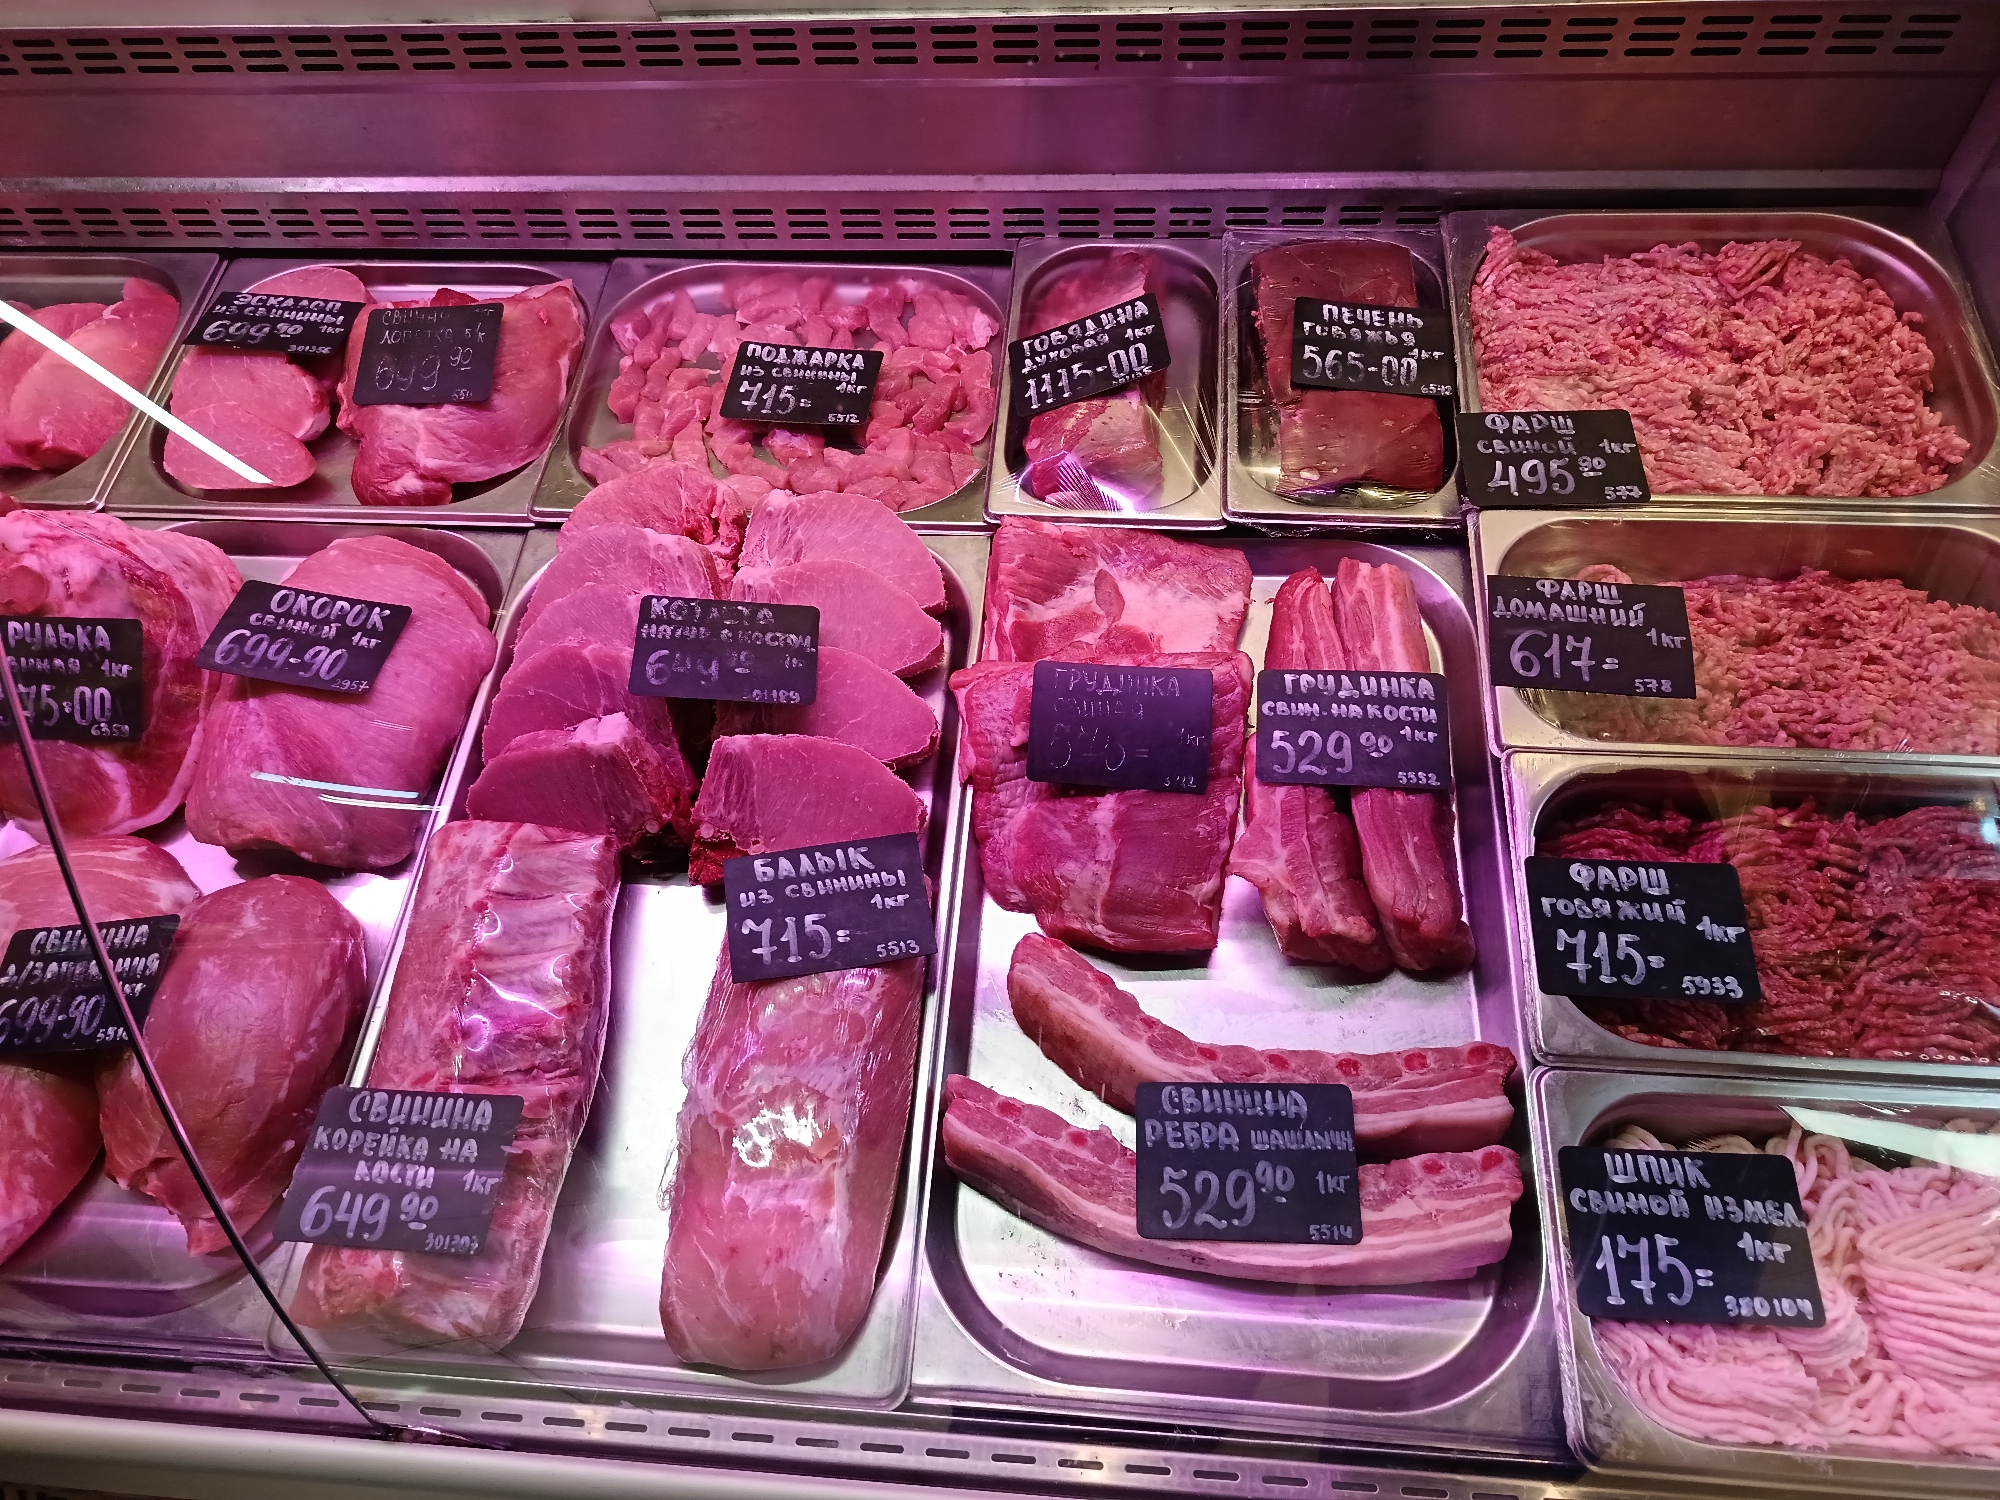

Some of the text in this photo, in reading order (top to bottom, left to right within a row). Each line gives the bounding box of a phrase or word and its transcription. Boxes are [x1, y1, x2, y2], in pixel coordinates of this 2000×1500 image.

[233, 294, 341, 312] ЭСКАЛОП
[1322, 304, 1423, 329] ПЕЧЕНЬ
[1023, 301, 1149, 356] ГОВЯДИНА
[747, 344, 864, 370] ПОДЖАРКА
[1485, 414, 1575, 434] ФАРШ
[1487, 458, 1575, 496] 495
[1536, 579, 1623, 605] ФАРШ
[271, 589, 391, 631] ОКОРОК
[1493, 595, 1646, 627] ДОМАШНИЙ
[8, 621, 111, 652] РУЛЬКА
[332, 679, 369, 690] 2957
[1284, 674, 1435, 700] ГРУДИНКА
[1635, 678, 1672, 693] 578
[1271, 730, 1353, 776] 529
[754, 847, 875, 882] БАЛЫК
[1569, 862, 1670, 896] ФАРШ
[876, 940, 920, 957] 5513
[1682, 975, 1743, 998] 5933
[349, 1091, 493, 1132] СВИНИНА
[1161, 1085, 1308, 1118] СВИНИНА
[313, 1125, 478, 1163] КОРЕЙКА НА
[1145, 1119, 1239, 1150] РЕБРА
[354, 1160, 435, 1189] КОСТИ
[1604, 1153, 1711, 1188] ШПИК
[300, 1185, 391, 1242] 649
[1159, 1166, 1255, 1230] 529
